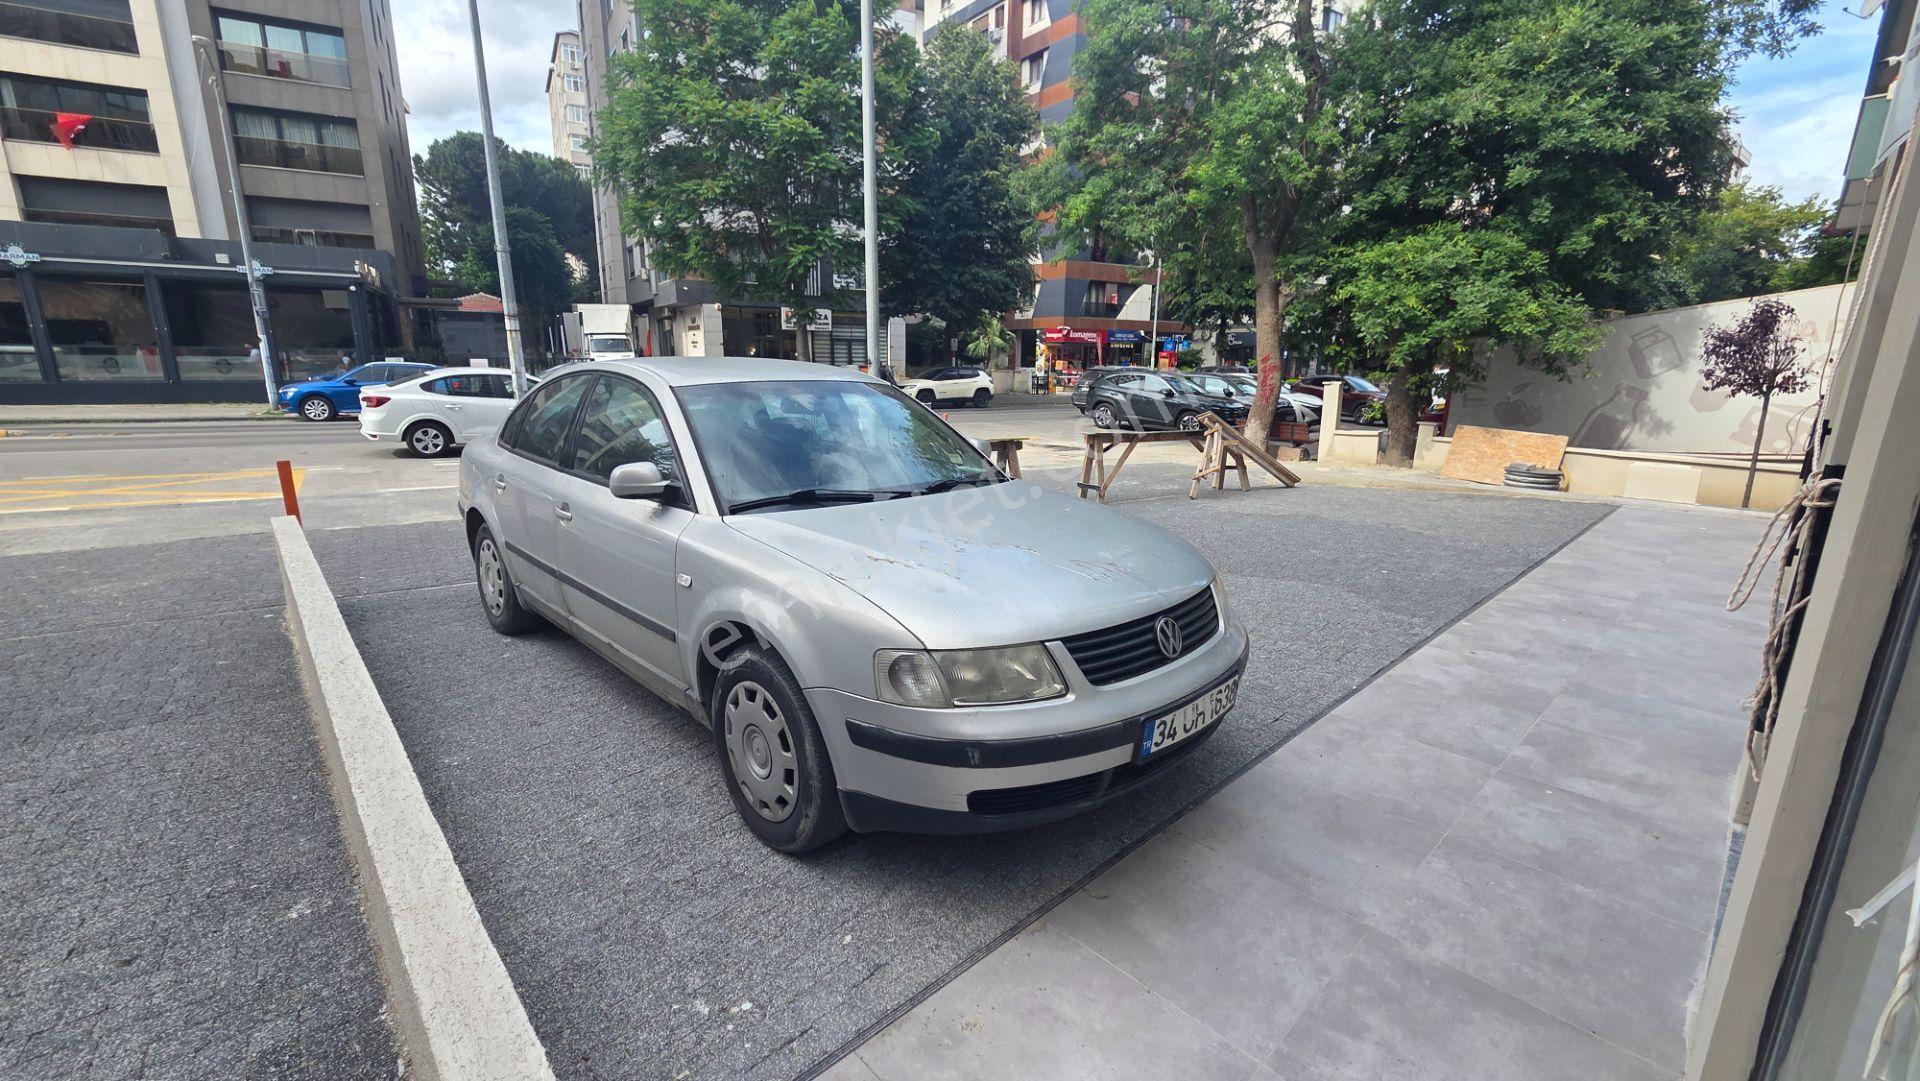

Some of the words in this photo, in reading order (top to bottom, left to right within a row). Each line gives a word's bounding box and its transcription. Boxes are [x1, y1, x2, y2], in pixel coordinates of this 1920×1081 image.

[238, 266, 273, 274] HMAN
[1154, 713, 1178, 748] 34
[1143, 740, 1151, 750] TR
